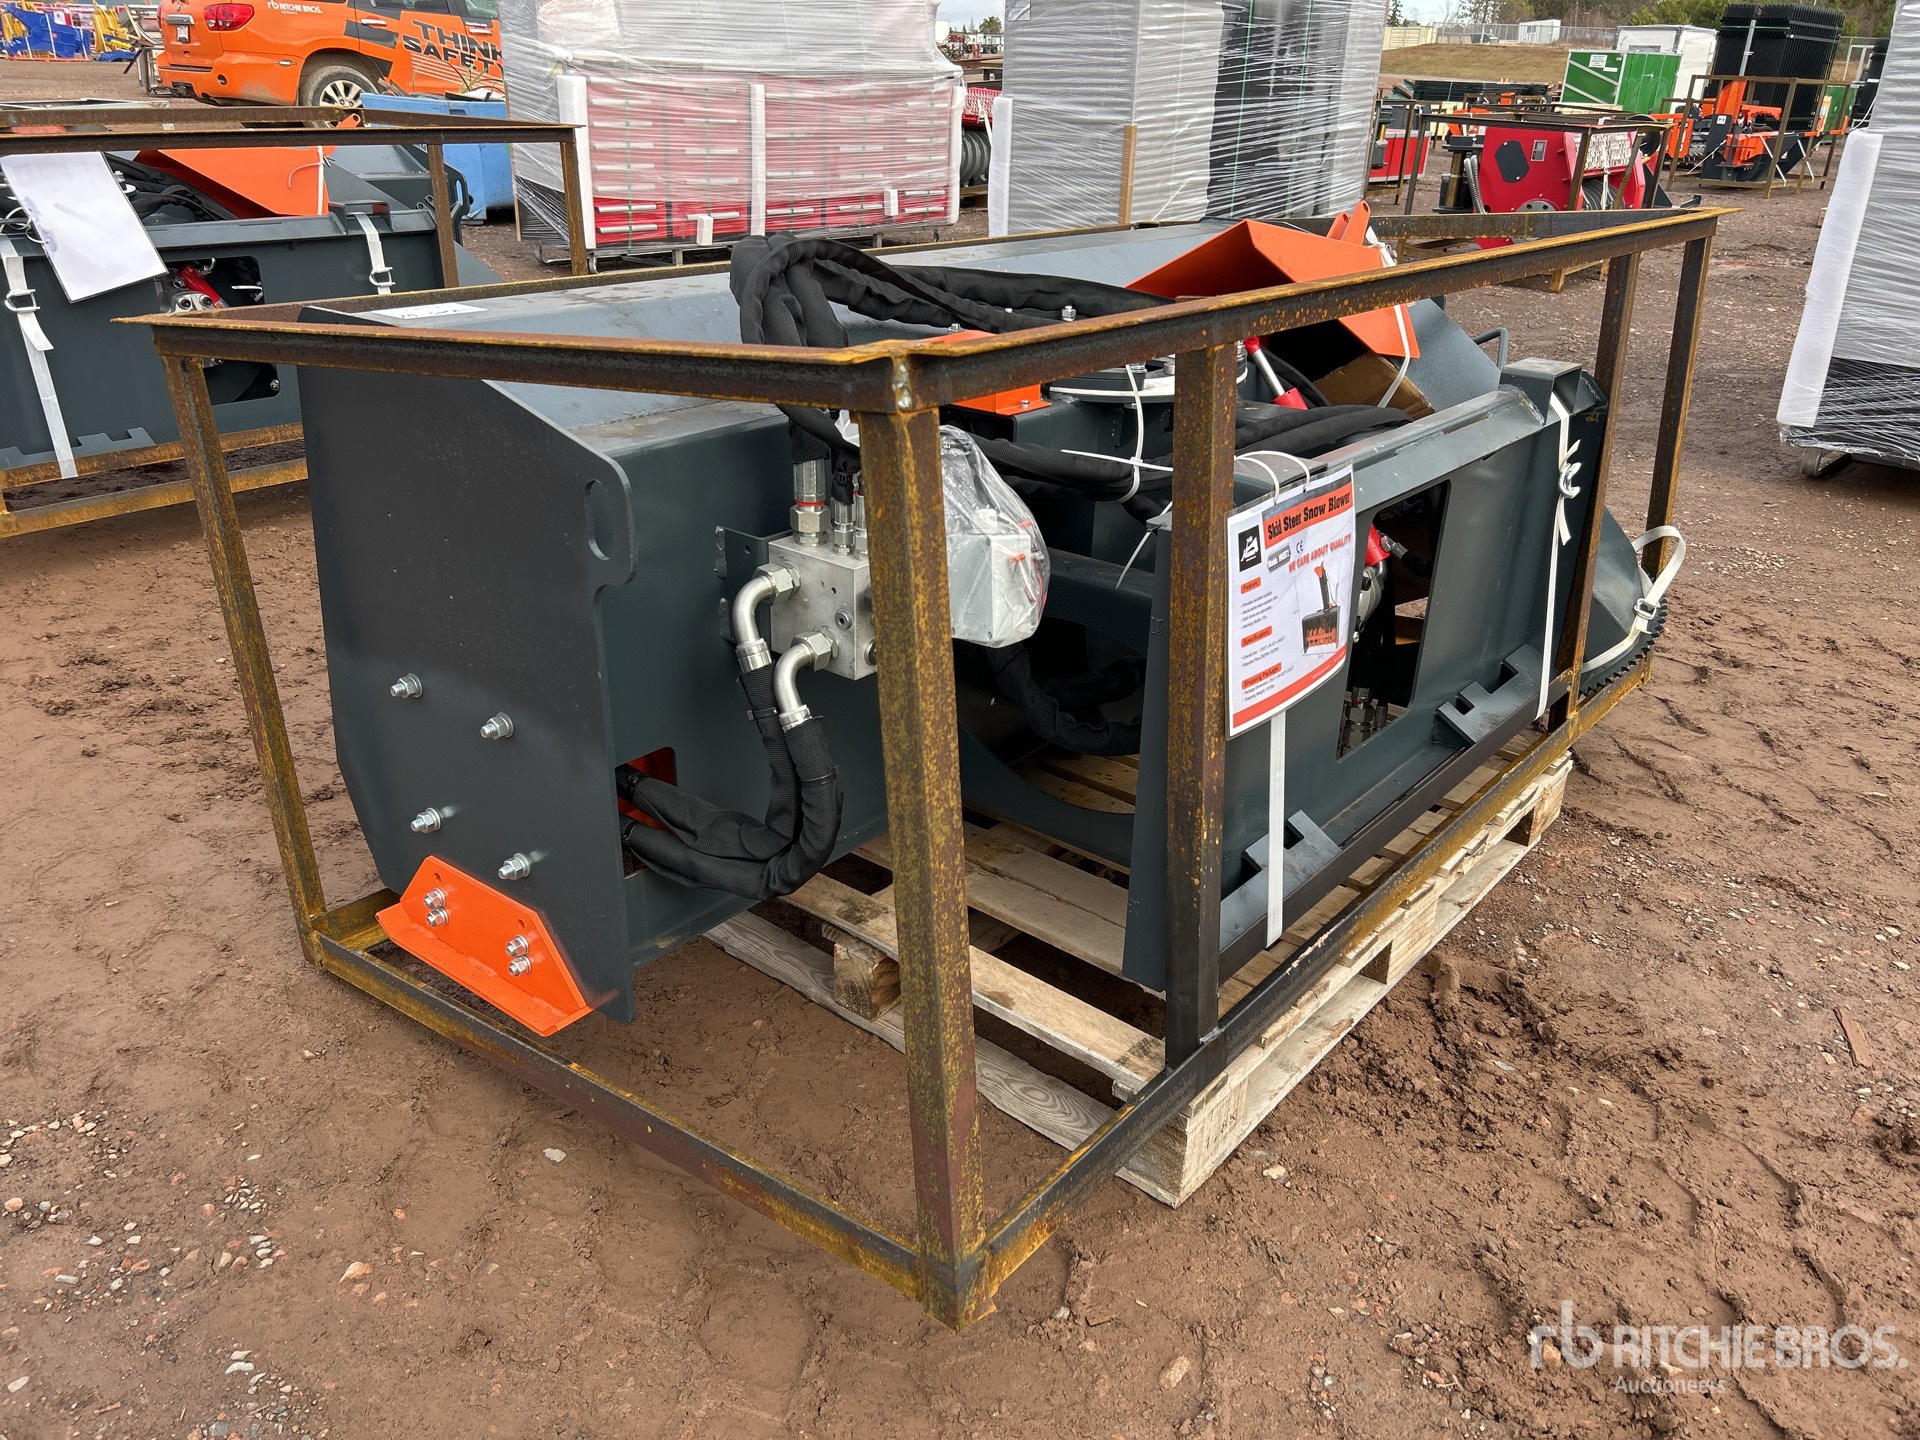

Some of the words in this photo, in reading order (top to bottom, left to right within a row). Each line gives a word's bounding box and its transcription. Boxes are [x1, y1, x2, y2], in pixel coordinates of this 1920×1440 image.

[1268, 519, 1282, 540] Skid
[1283, 513, 1302, 532] Steer
[1303, 503, 1326, 522] Snow
[1328, 492, 1350, 512] Blower
[1297, 553, 1310, 568] CARE
[1311, 544, 1328, 561] ABOUT
[1329, 532, 1351, 551] QUALITY
